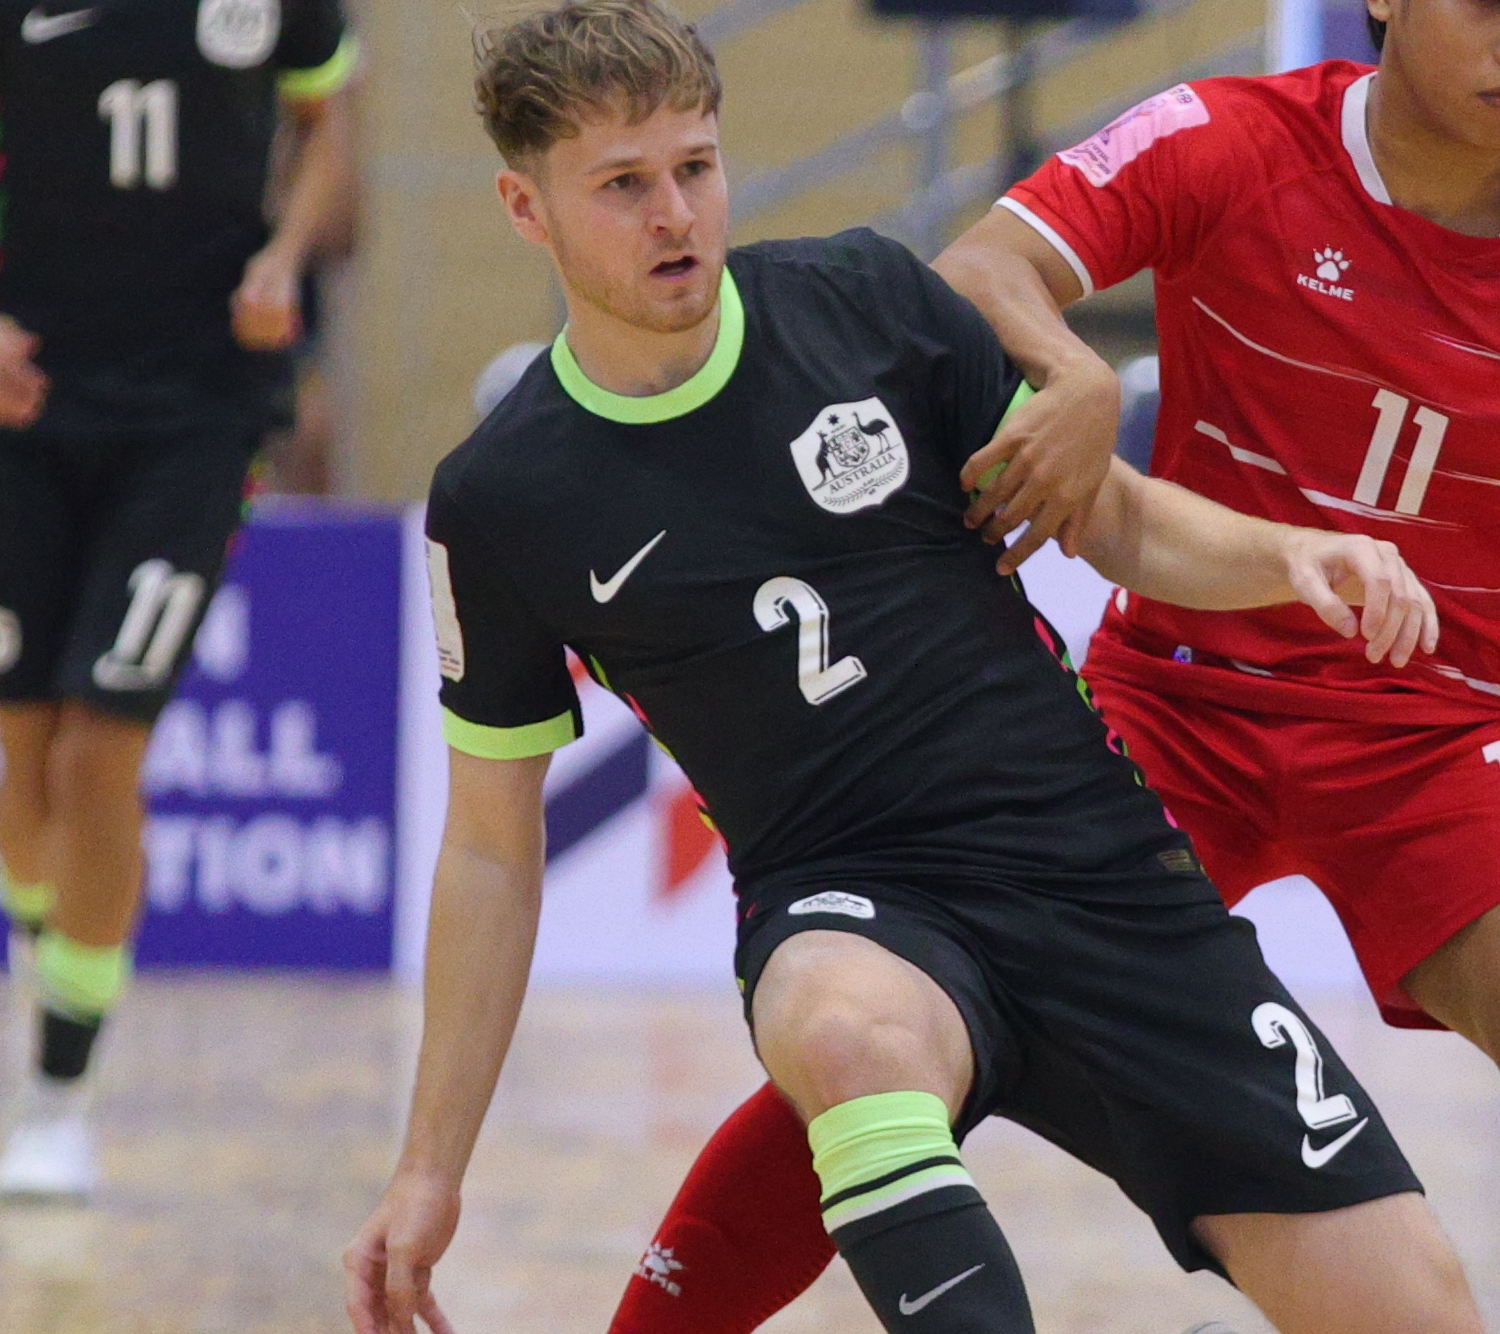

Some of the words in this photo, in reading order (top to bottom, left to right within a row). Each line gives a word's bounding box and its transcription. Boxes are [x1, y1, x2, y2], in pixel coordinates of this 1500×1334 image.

[97, 78, 180, 190] 11
[1296, 273, 1355, 302] KELME
[829, 452, 896, 494] AUSTRALIA
[1352, 387, 1450, 517] 11
[752, 575, 868, 707] 2
[1251, 1001, 1358, 1131] 2
